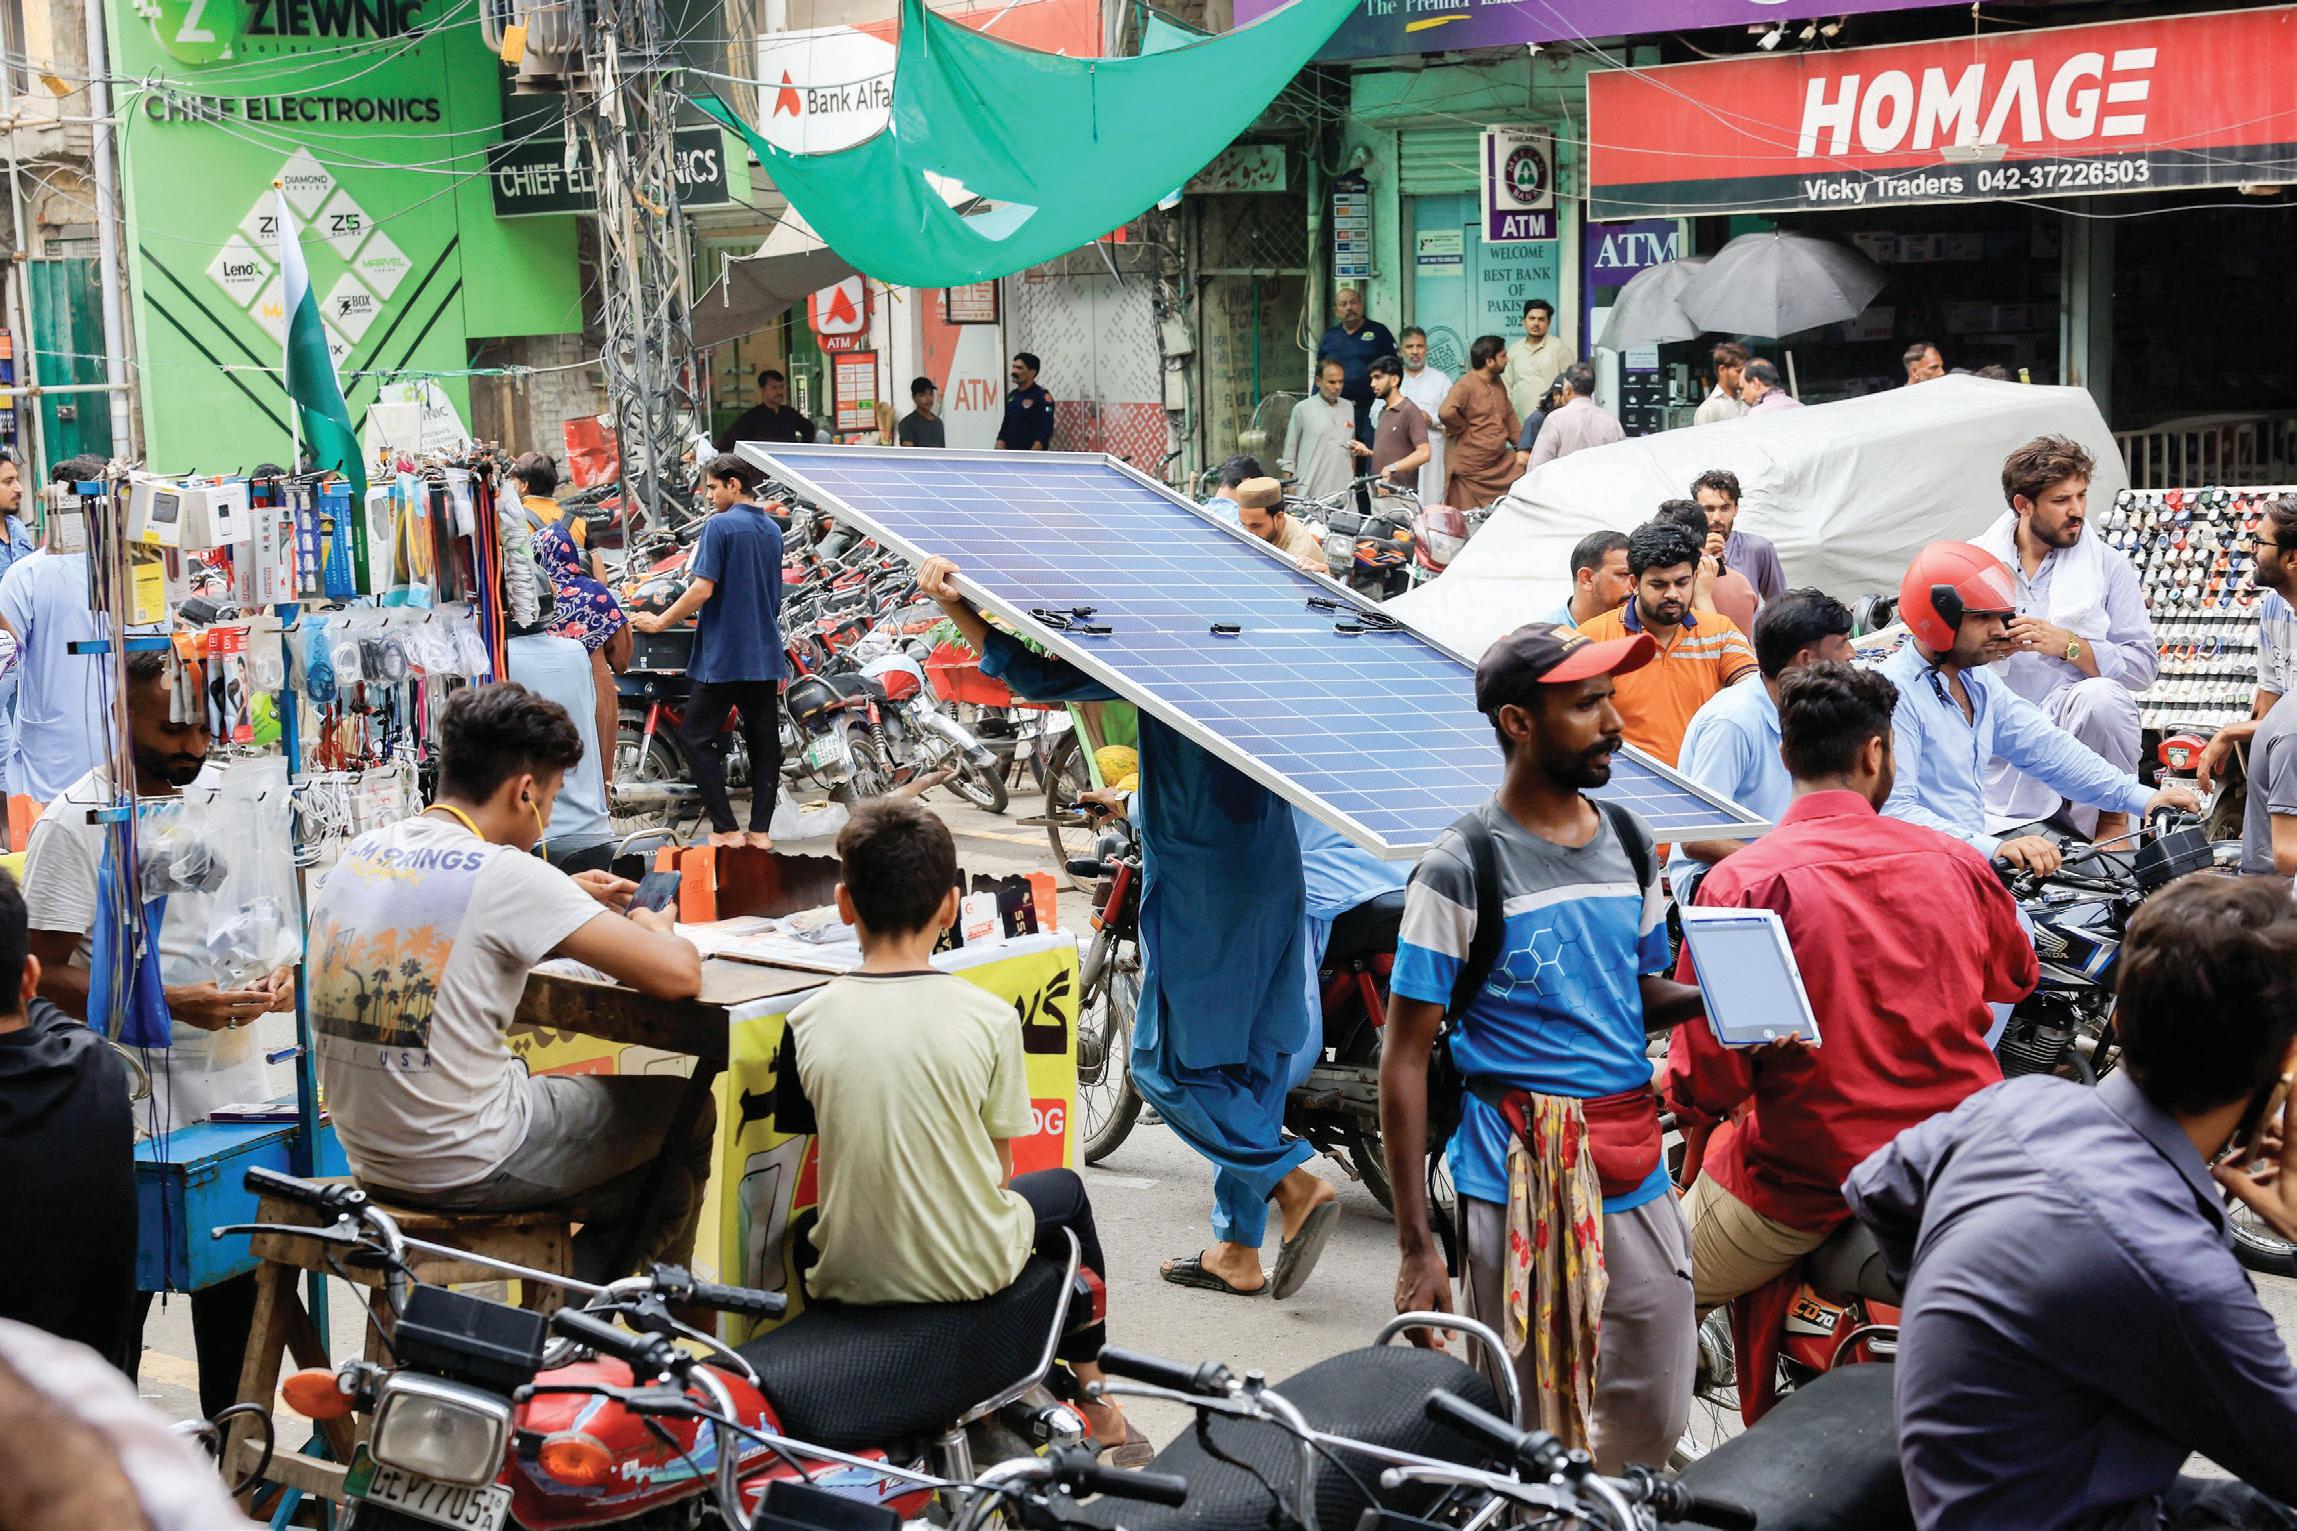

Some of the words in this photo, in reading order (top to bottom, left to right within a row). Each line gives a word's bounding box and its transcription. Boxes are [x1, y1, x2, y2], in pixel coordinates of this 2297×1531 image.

[1366, 1, 1398, 16] The
[246, 0, 424, 38] ZIEWNIC
[145, 96, 235, 123] CHIEF
[246, 96, 441, 123] ELECTRONICS
[807, 87, 851, 114] Bank
[1797, 48, 2157, 158] HOMAGE
[285, 175, 328, 184] DIAMOND
[500, 163, 561, 197] CHIEF
[1804, 179, 1866, 204] Vicky
[1873, 174, 1963, 197] Traders
[1977, 160, 2150, 192] 042-37226503
[330, 213, 361, 231] Z5
[1502, 215, 1546, 237] ATM
[1490, 246, 1544, 260] WELCOME
[1594, 231, 1680, 267] ATM
[1484, 269, 1513, 282] BEST
[1516, 267, 1551, 280] BANK
[1508, 284, 1526, 296] OF
[1487, 300, 1524, 312] PAKIS
[827, 337, 850, 349] ATM
[954, 379, 998, 412] ATM
[791, 688, 817, 702] HONDA
[2034, 950, 2069, 959] ONDA
